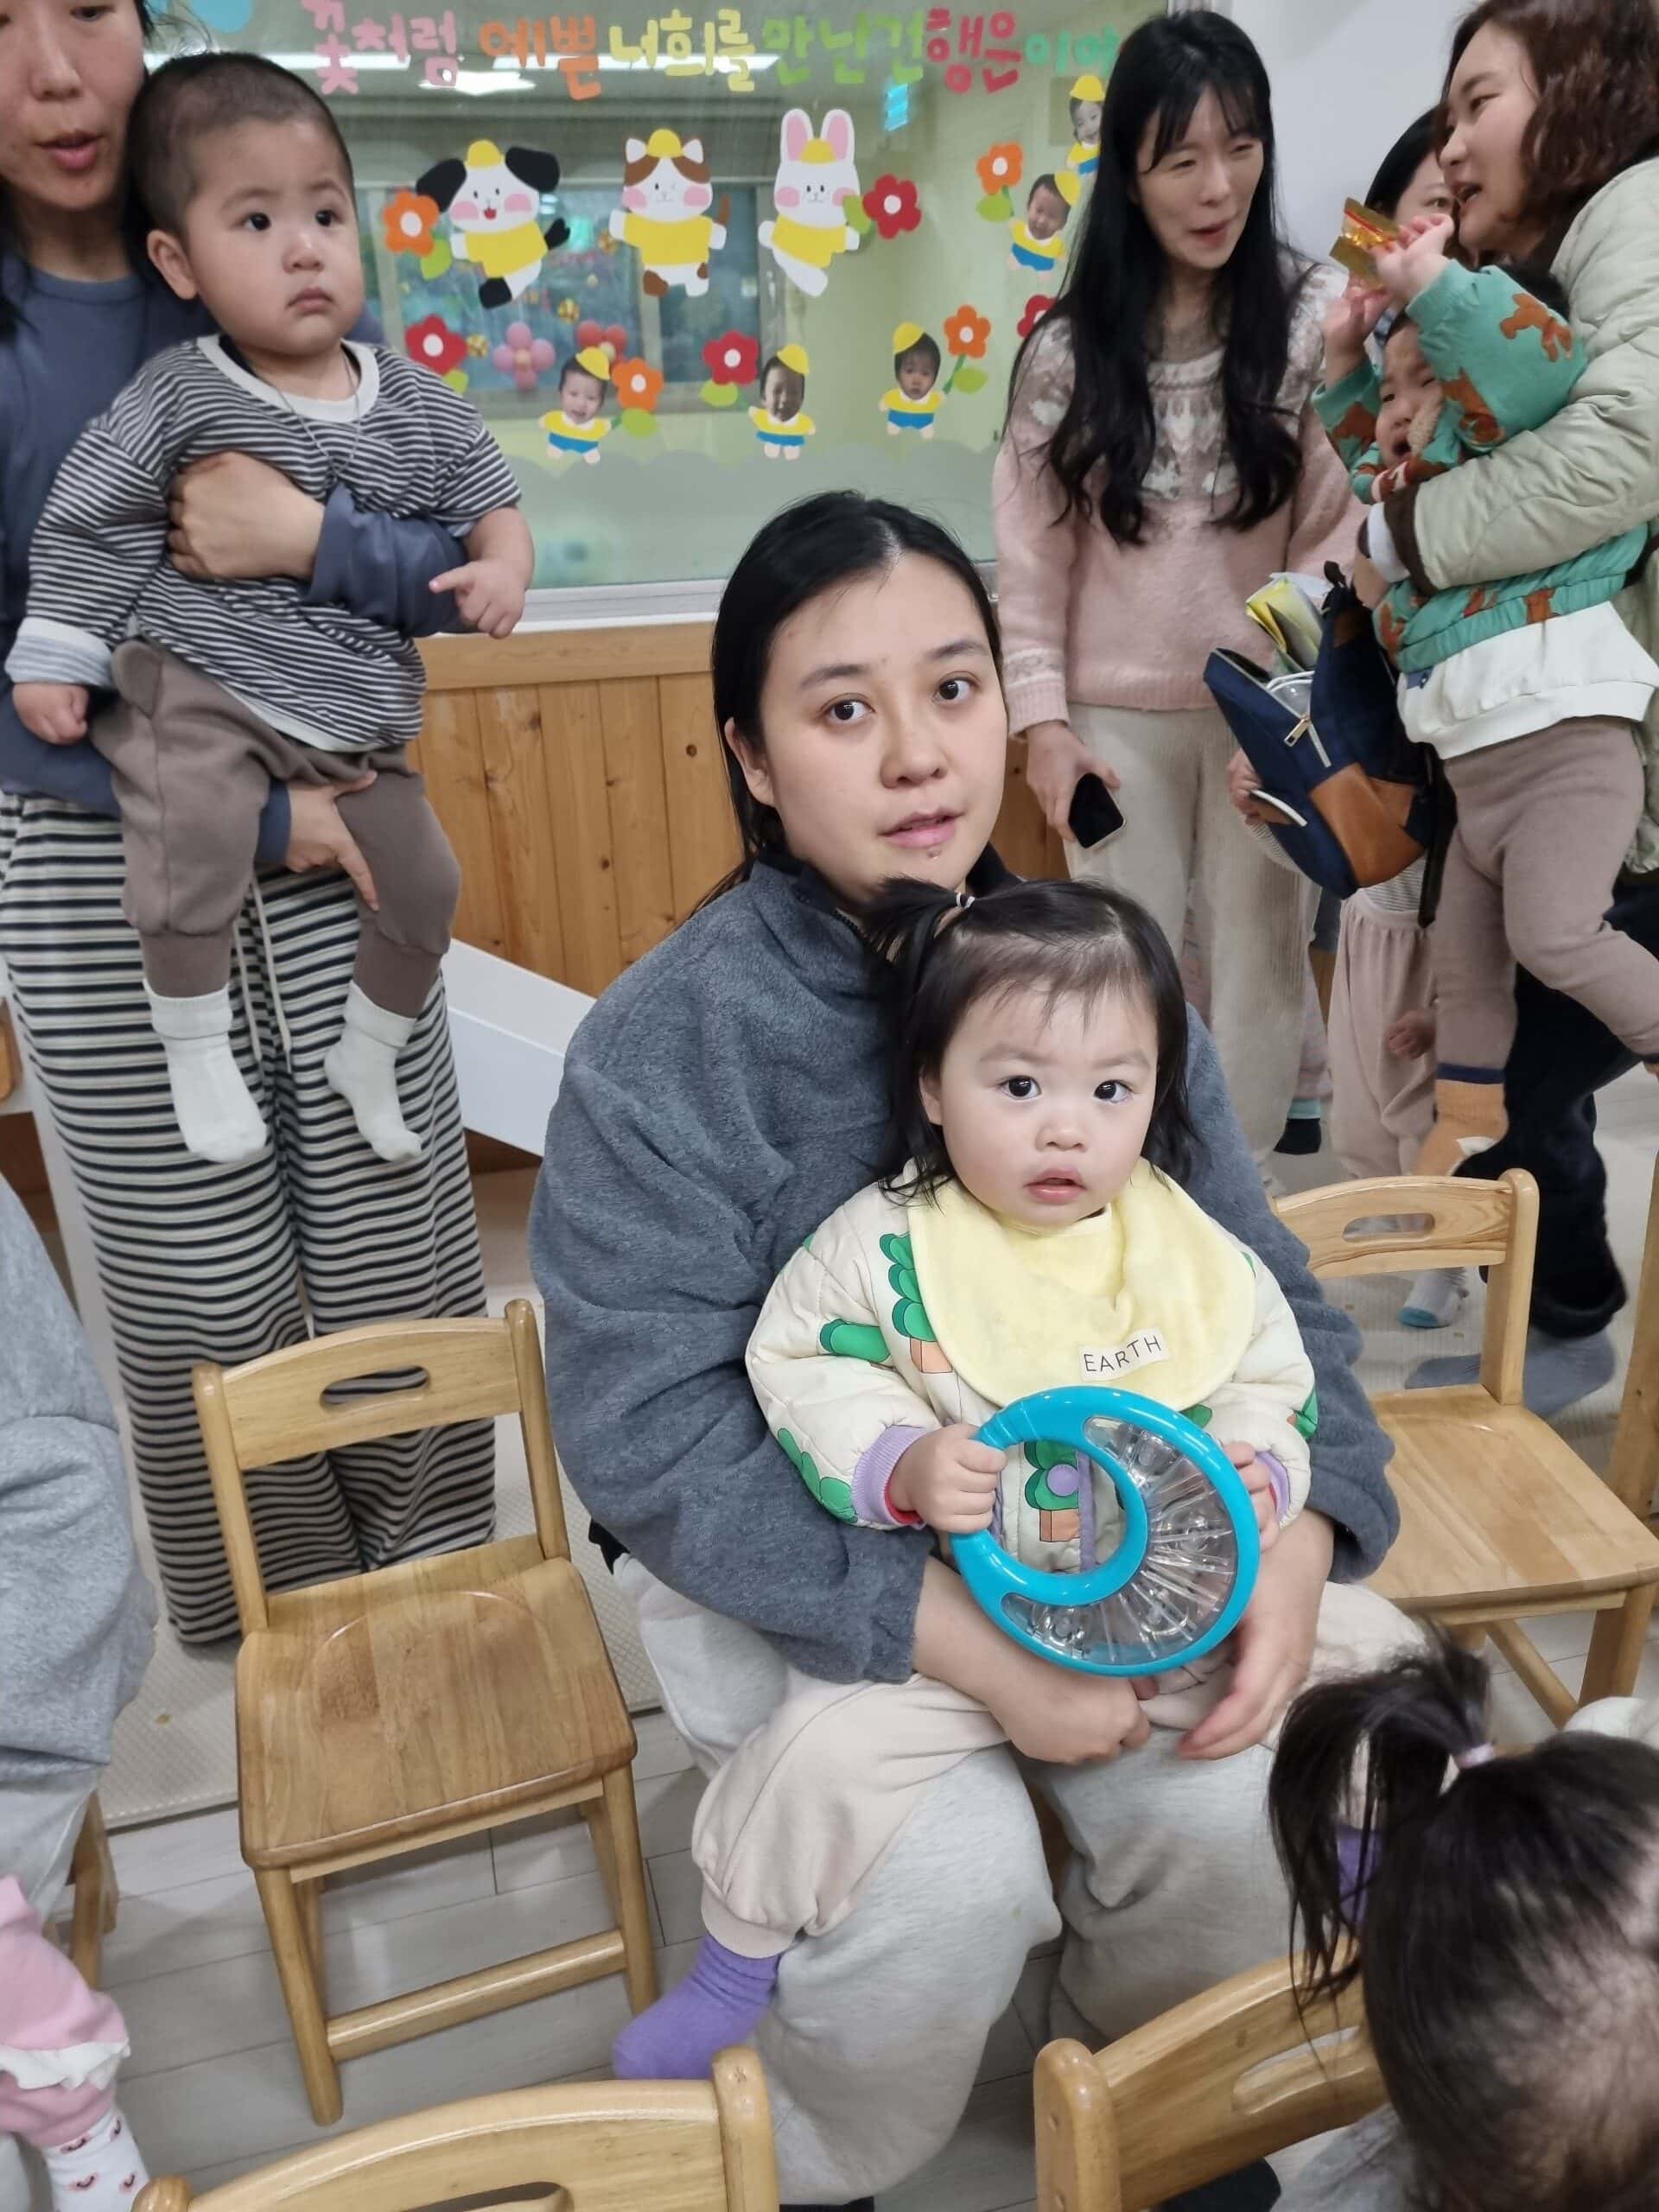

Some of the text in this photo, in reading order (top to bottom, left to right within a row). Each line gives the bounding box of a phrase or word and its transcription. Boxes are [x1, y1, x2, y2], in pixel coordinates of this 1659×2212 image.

[300, 0, 458, 95] 꽃처럼
[478, 14, 602, 101] 예쁜
[609, 8, 756, 92] 너희를
[1083, 1335, 1162, 1372] EARTH
